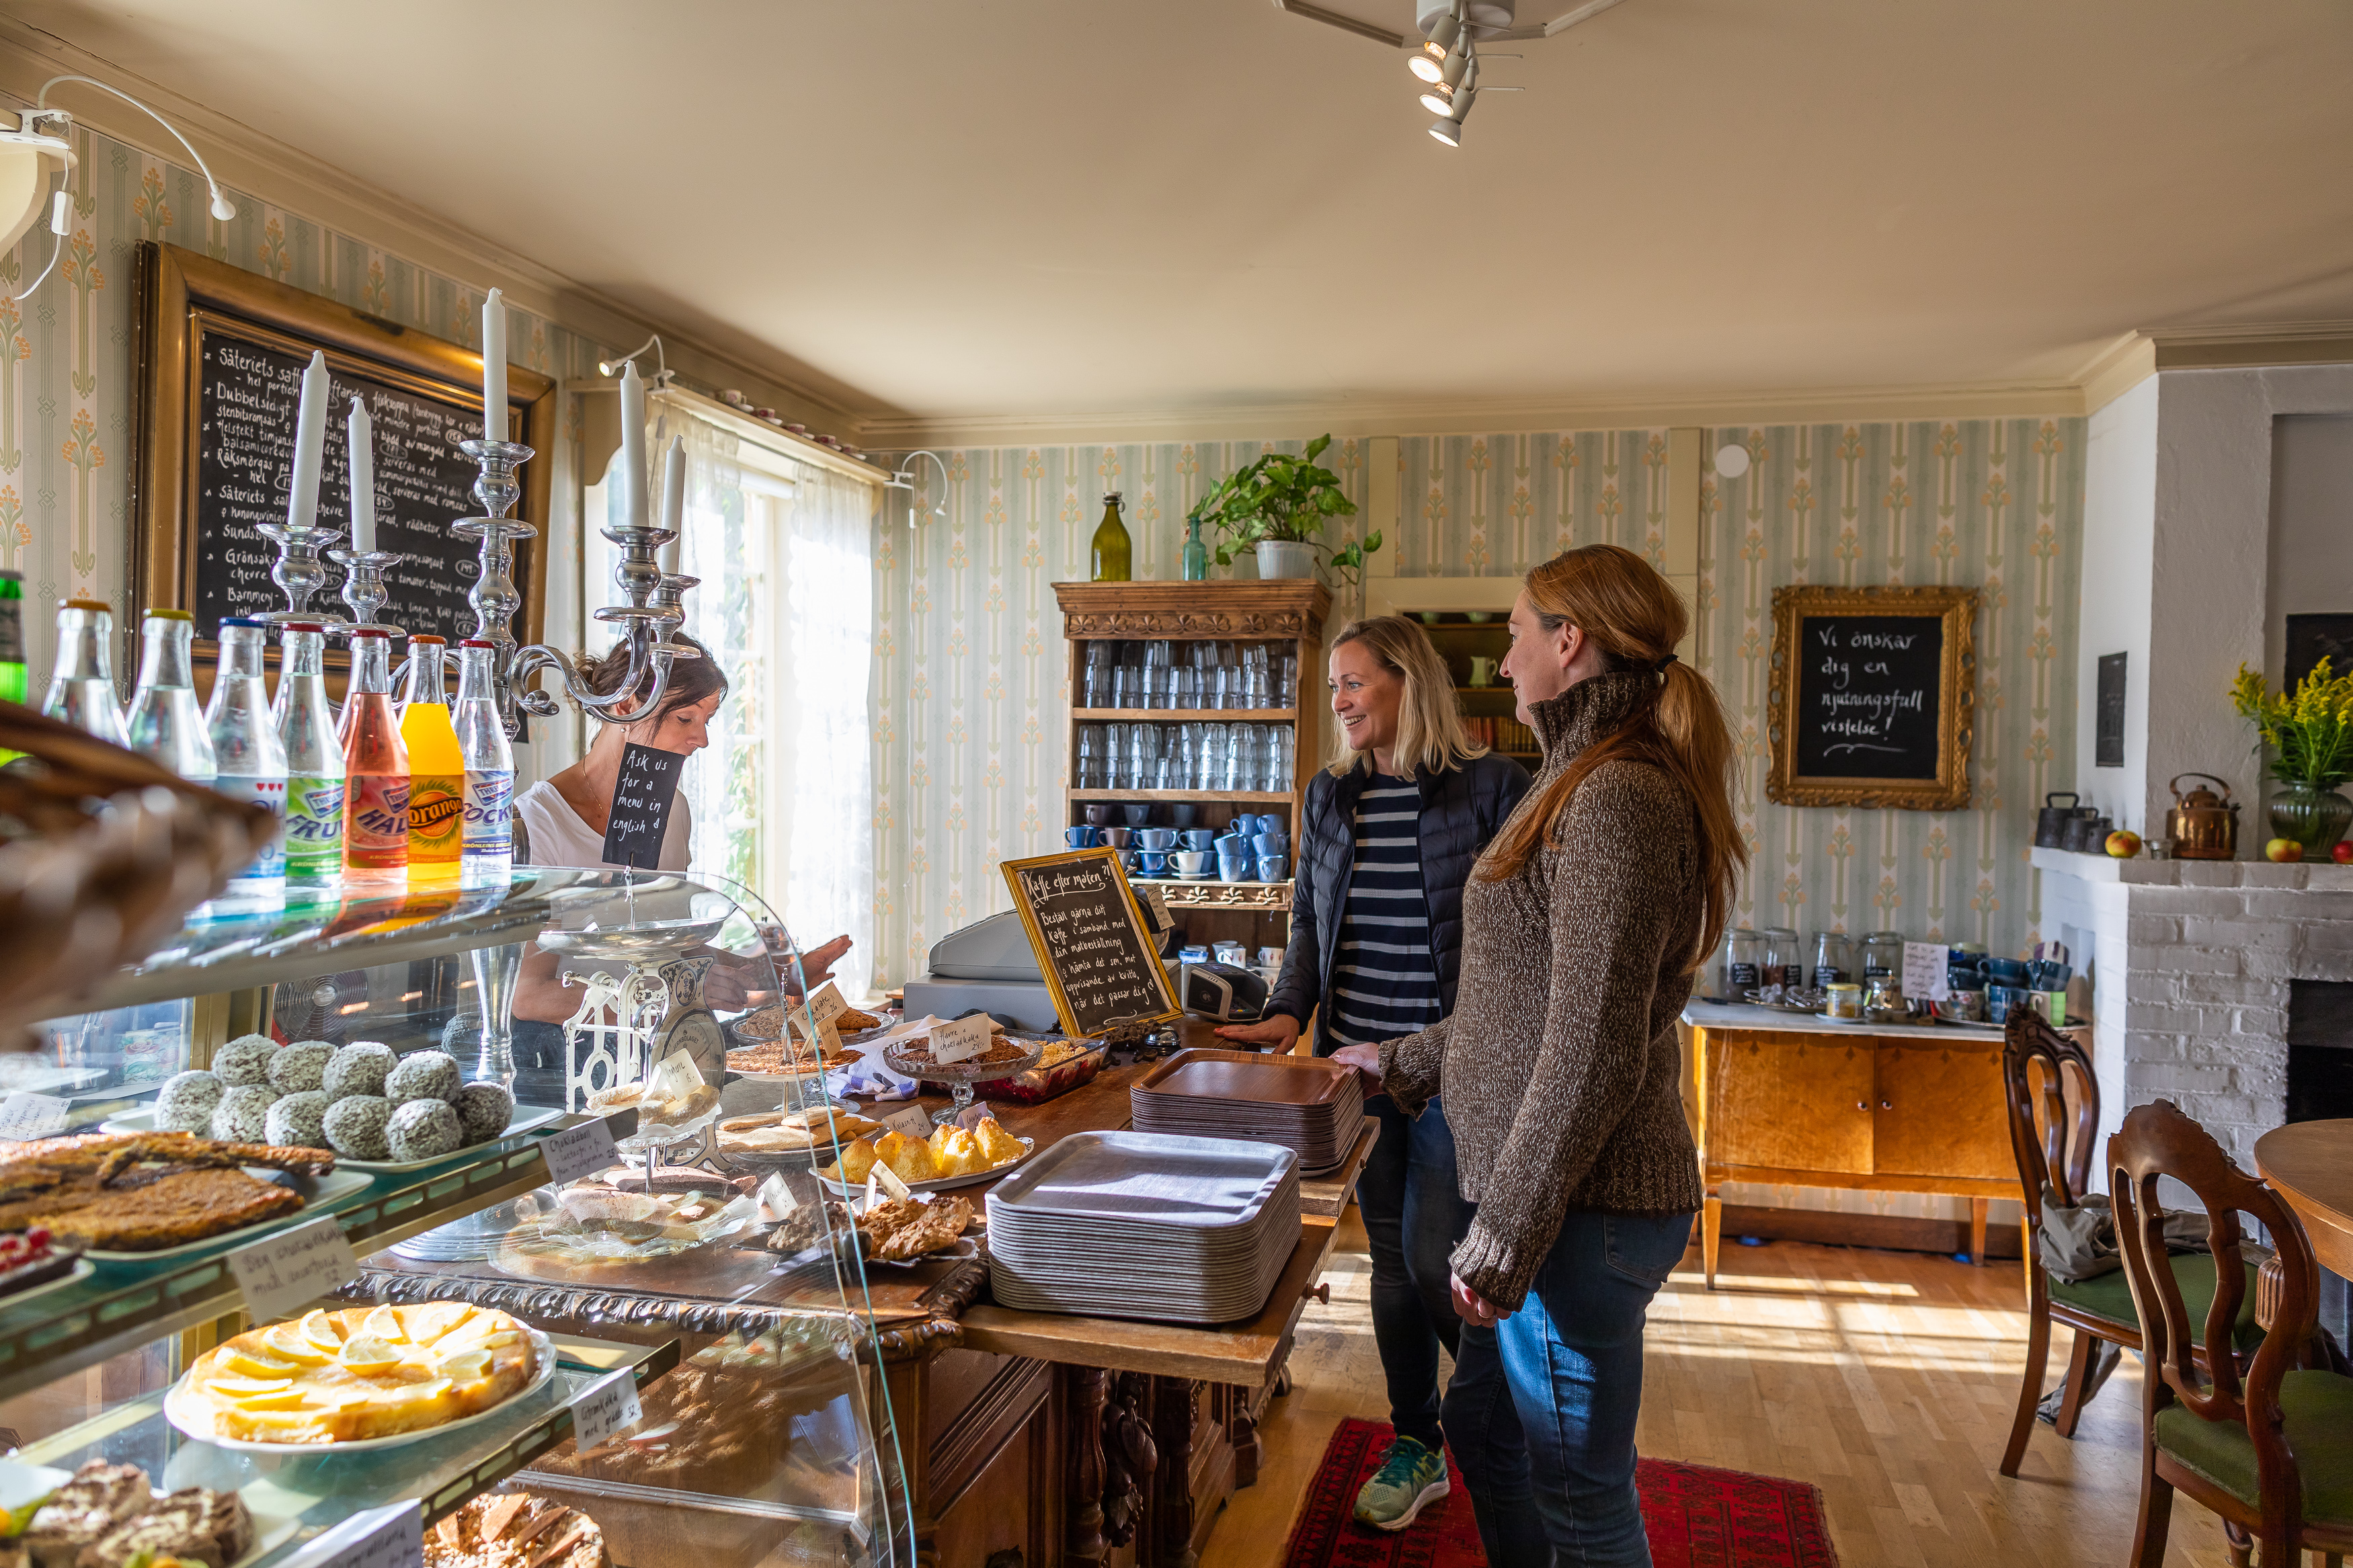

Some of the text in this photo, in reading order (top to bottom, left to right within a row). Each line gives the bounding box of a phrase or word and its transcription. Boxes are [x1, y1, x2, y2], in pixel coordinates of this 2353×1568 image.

[219, 347, 274, 378] Säteriets
[216, 381, 291, 423] Dubbelsidigt
[217, 448, 273, 476] Räksmörgås
[219, 485, 266, 503] Säteriets
[1819, 625, 1917, 650] Vi önskar
[1821, 656, 1890, 690] dig en
[1821, 689, 1923, 720] njutningsfull
[627, 749, 668, 772] Ask us
[621, 772, 653, 795] for a
[409, 798, 463, 824] orango
[617, 795, 661, 813] menu in
[286, 814, 344, 839] FRU
[356, 809, 409, 834] HAL
[612, 819, 646, 842] english
[1025, 872, 1051, 901] Kaffe
[1053, 872, 1070, 897] efter
[1074, 871, 1101, 889] maten
[1040, 904, 1106, 927] Beställ gärna ditt
[1073, 926, 1077, 935] i
[1080, 921, 1109, 935] samband
[1112, 918, 1126, 929] med
[1054, 938, 1122, 958] din matbeställning
[1068, 960, 1091, 975] hämta
[1095, 956, 1106, 968] det
[1125, 955, 1136, 964] mot
[1107, 974, 1115, 983] av
[1074, 985, 1150, 1012] när det passar dig
[939, 1029, 959, 1042] Havre
[940, 1033, 980, 1052] chokladkaka
